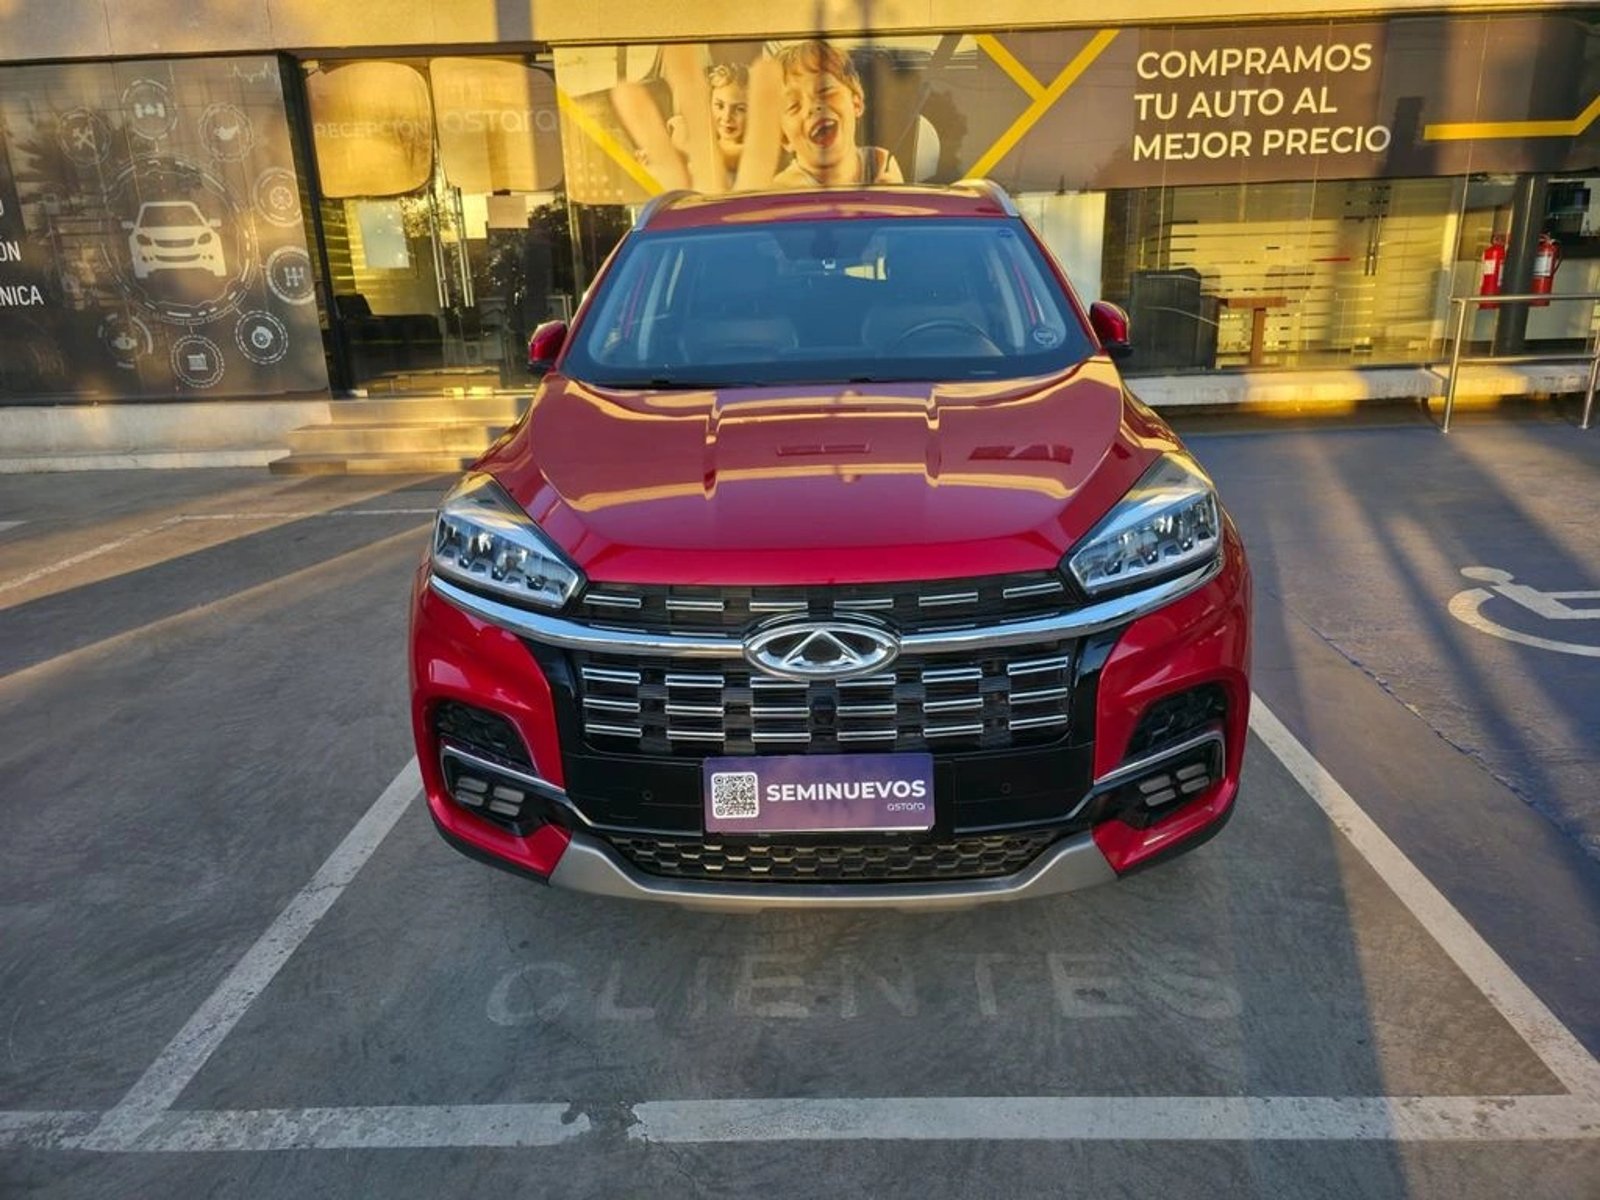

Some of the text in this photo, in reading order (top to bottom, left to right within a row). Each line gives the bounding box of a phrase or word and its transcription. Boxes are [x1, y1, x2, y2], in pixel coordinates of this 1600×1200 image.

[1136, 43, 1372, 79] COMPRAMOS
[1134, 86, 1338, 121] TU AUTO AL
[1133, 125, 1392, 162] MEJOR PRECIO
[0, 285, 44, 306] NICA
[766, 780, 926, 802] SEMINUEVOS
[887, 802, 925, 812] astara
[486, 953, 1243, 1028] CLIENTES
